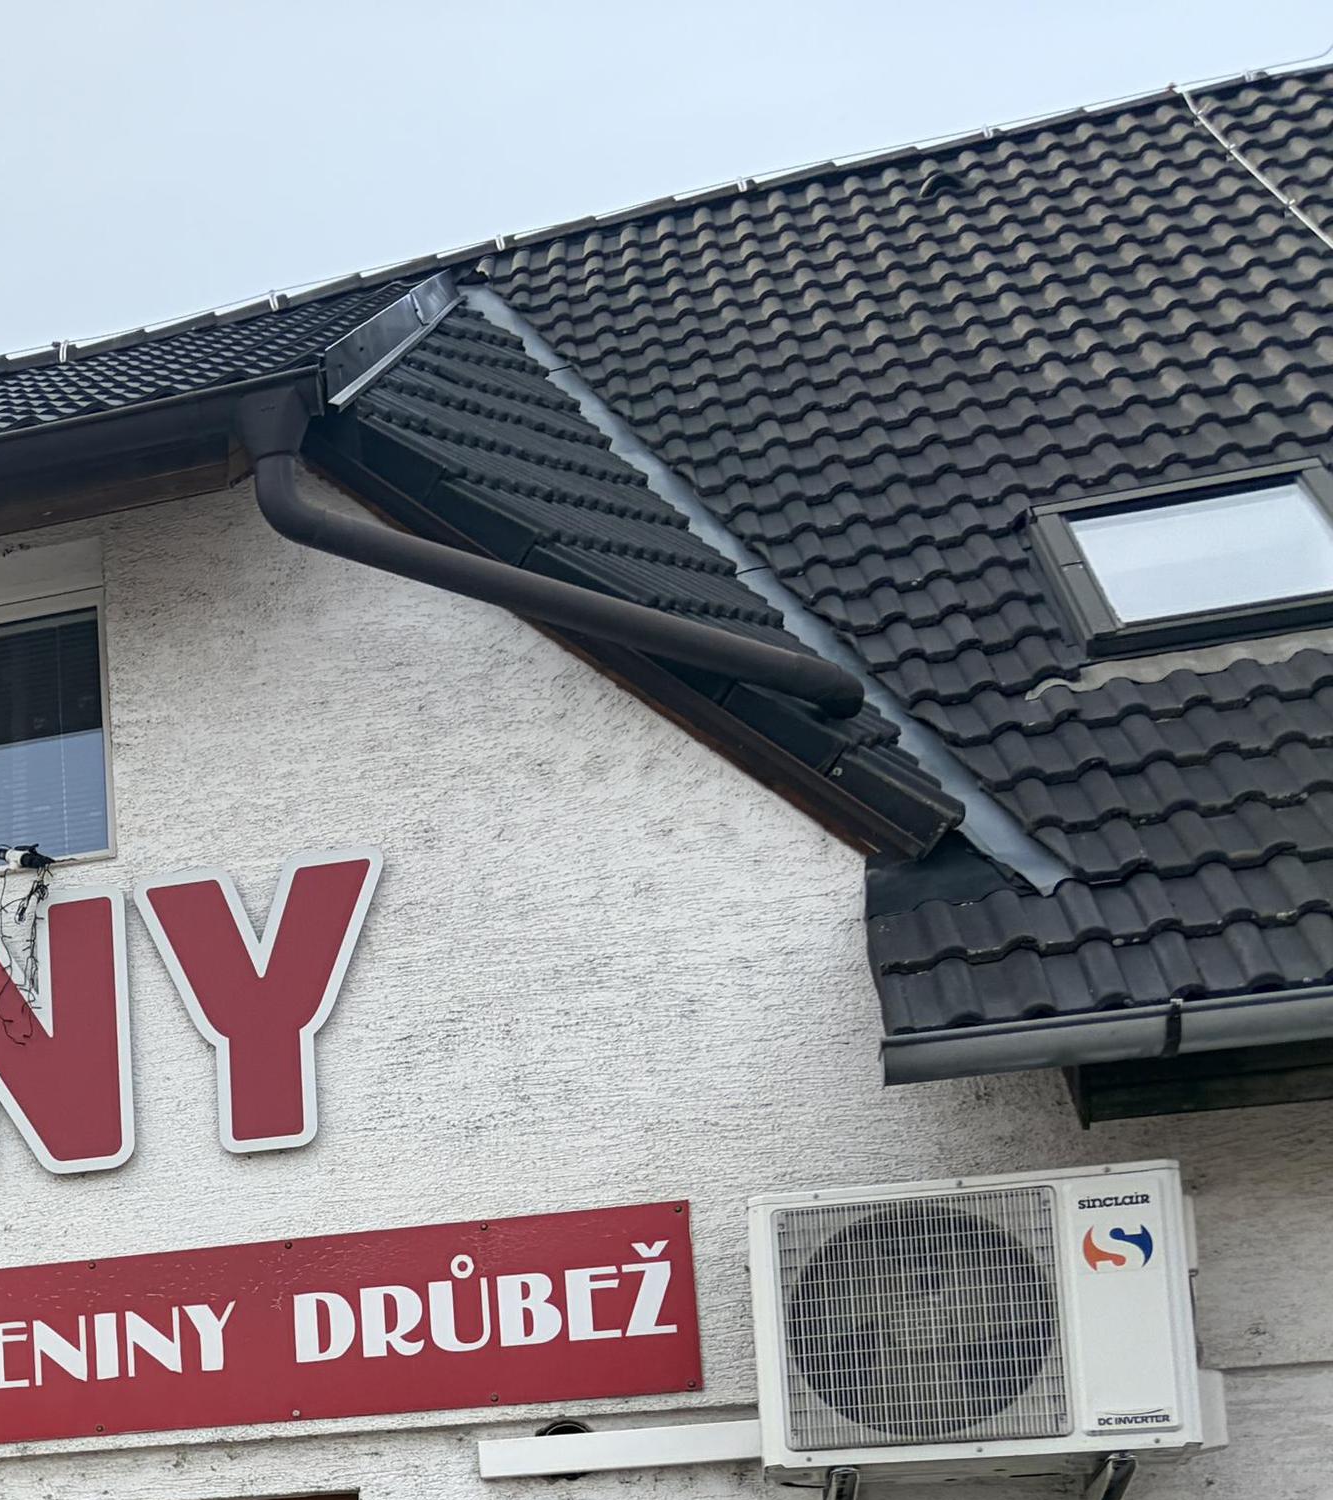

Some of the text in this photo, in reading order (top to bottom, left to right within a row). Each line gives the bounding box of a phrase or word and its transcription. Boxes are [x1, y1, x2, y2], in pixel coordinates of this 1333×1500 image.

[294, 1240, 678, 1364] DRŮBEŽ
[1098, 1413, 1171, 1426] DC INVERTER
